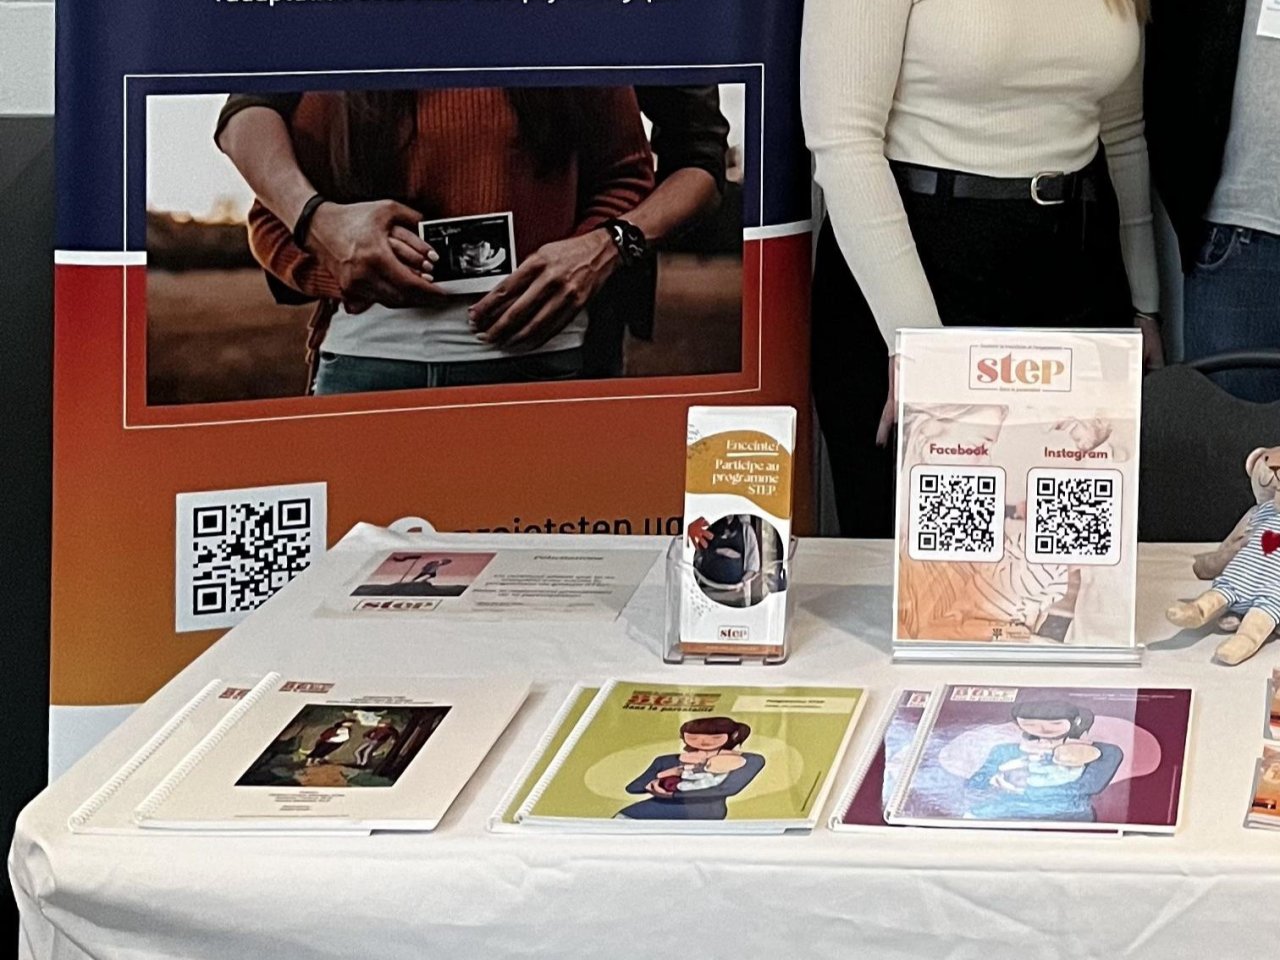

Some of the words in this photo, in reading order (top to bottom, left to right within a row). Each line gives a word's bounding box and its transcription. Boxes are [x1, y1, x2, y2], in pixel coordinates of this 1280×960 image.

[977, 351, 1065, 384] step
[929, 443, 989, 456] Facebook
[1044, 446, 1108, 461] Instagram
[715, 459, 764, 473] Participe
[766, 464, 780, 472] au
[712, 473, 779, 485] programme
[720, 628, 747, 638] step
